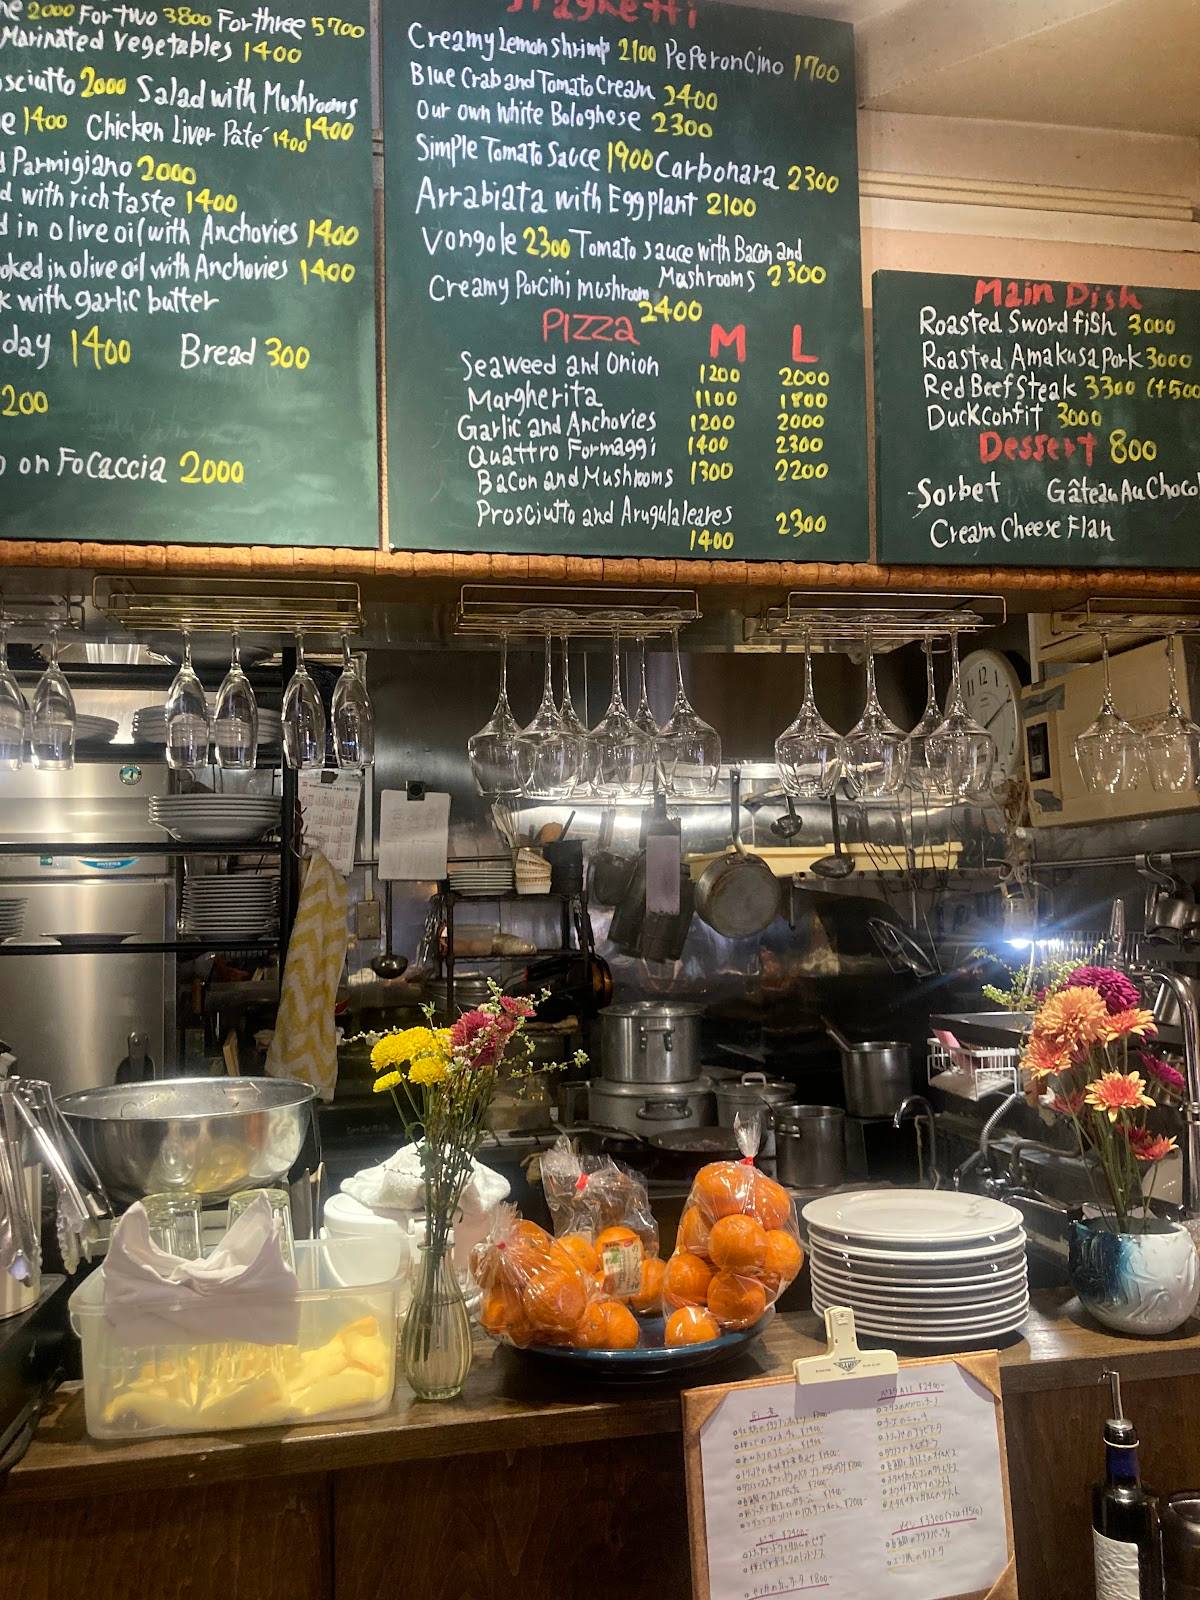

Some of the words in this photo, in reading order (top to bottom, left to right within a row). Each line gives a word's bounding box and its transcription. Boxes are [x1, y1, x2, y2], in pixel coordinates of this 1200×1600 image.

[27, 1, 75, 19] 2000
[163, 6, 212, 27] 3800
[311, 16, 366, 38] 5700
[0, 25, 104, 51] Marinated
[114, 30, 232, 62] Vegetables
[244, 41, 302, 64] 1400
[408, 22, 495, 62] Creamy
[499, 26, 548, 56] Lemon
[618, 38, 657, 63] 2100
[793, 54, 840, 81] 1700
[80, 66, 127, 97] 2000
[136, 75, 205, 109] Salad
[211, 78, 256, 113] with
[410, 61, 456, 87] Blue
[461, 67, 501, 89] Crab
[504, 69, 535, 91] and
[537, 69, 594, 97] Tomato
[596, 75, 656, 100] Cream
[663, 83, 718, 111] 2400
[24, 106, 68, 135] 1400
[86, 111, 164, 143] Chicken
[172, 115, 217, 147] Liver
[272, 132, 308, 153] 1400
[305, 116, 354, 141] 1400
[417, 100, 451, 119] Our
[457, 104, 491, 124] own
[650, 111, 713, 137] 2300
[12, 145, 132, 185] Parmigiano
[137, 156, 197, 185] 2000
[481, 135, 543, 166] Tomato
[607, 140, 654, 173] 1900
[655, 151, 780, 190] Carbonara
[787, 165, 840, 194] 2300
[21, 181, 64, 208] with
[69, 181, 109, 210] rich
[112, 183, 175, 217] taste
[186, 189, 238, 214] 1400
[415, 176, 548, 214] Arrabiata
[555, 180, 601, 213] with
[706, 192, 757, 217] 2100
[17, 212, 38, 238] in
[49, 214, 109, 243] olive
[114, 216, 146, 244] oil
[148, 221, 190, 246] with
[200, 211, 298, 247] Anchovies
[307, 218, 359, 247] 1400
[421, 222, 517, 256] Vongole
[522, 226, 571, 259] 2300
[568, 228, 637, 260] Tomato
[697, 234, 731, 264] with
[776, 238, 803, 262] and
[69, 249, 115, 280] olive
[120, 252, 146, 281] oil
[150, 254, 190, 283] with
[194, 252, 288, 282] Anchovies
[299, 258, 356, 285] 1400
[766, 260, 827, 287] 2300
[18, 283, 71, 314] with
[75, 286, 140, 319] garlic
[148, 285, 220, 314] butter
[429, 274, 509, 305] Creamy
[638, 296, 703, 323] 2400
[974, 279, 1055, 307] Main
[1065, 282, 1143, 312] Dish
[920, 305, 1002, 336] Roasted
[1127, 313, 1176, 336] 3000
[2, 324, 51, 370] day
[70, 326, 131, 370] 1400
[180, 333, 256, 369] Bread
[264, 337, 311, 369] 300
[710, 323, 746, 363] M
[792, 324, 819, 363] L
[922, 340, 1004, 371] Roasted
[1010, 341, 1101, 371] Amakusa
[1145, 346, 1193, 370] 3000
[460, 351, 557, 381] Seaweed
[566, 351, 599, 377] and
[606, 351, 659, 376] Onion
[699, 364, 741, 384] 1200
[778, 367, 830, 386] 2000
[467, 380, 603, 416] Margherita
[695, 390, 738, 408] 1100
[780, 391, 828, 409] 1800
[1084, 375, 1136, 400] 3300
[457, 414, 522, 441] Garlic
[528, 414, 561, 438] and
[566, 408, 657, 436] Anchovies
[690, 414, 736, 432] 1200
[777, 413, 825, 431] 2000
[1057, 401, 1102, 428] 3000
[468, 442, 559, 469] Quattro
[568, 437, 657, 461] Formaggi
[688, 434, 729, 455] 1400
[776, 435, 824, 454] 2300
[979, 431, 1097, 468] Dessert
[1109, 428, 1157, 464] 800
[19, 455, 50, 474] on
[179, 451, 244, 483] 2000
[543, 466, 578, 492] and
[690, 460, 734, 486] 1300
[774, 459, 829, 482] 2200
[917, 470, 1001, 510] Sorbet
[582, 500, 614, 527] and
[775, 508, 827, 537] 2300
[930, 518, 996, 549] Cream
[1001, 512, 1061, 542] Cheese
[1067, 514, 1116, 542] Flan
[689, 529, 735, 553] 1400
[978, 666, 988, 686] 12
